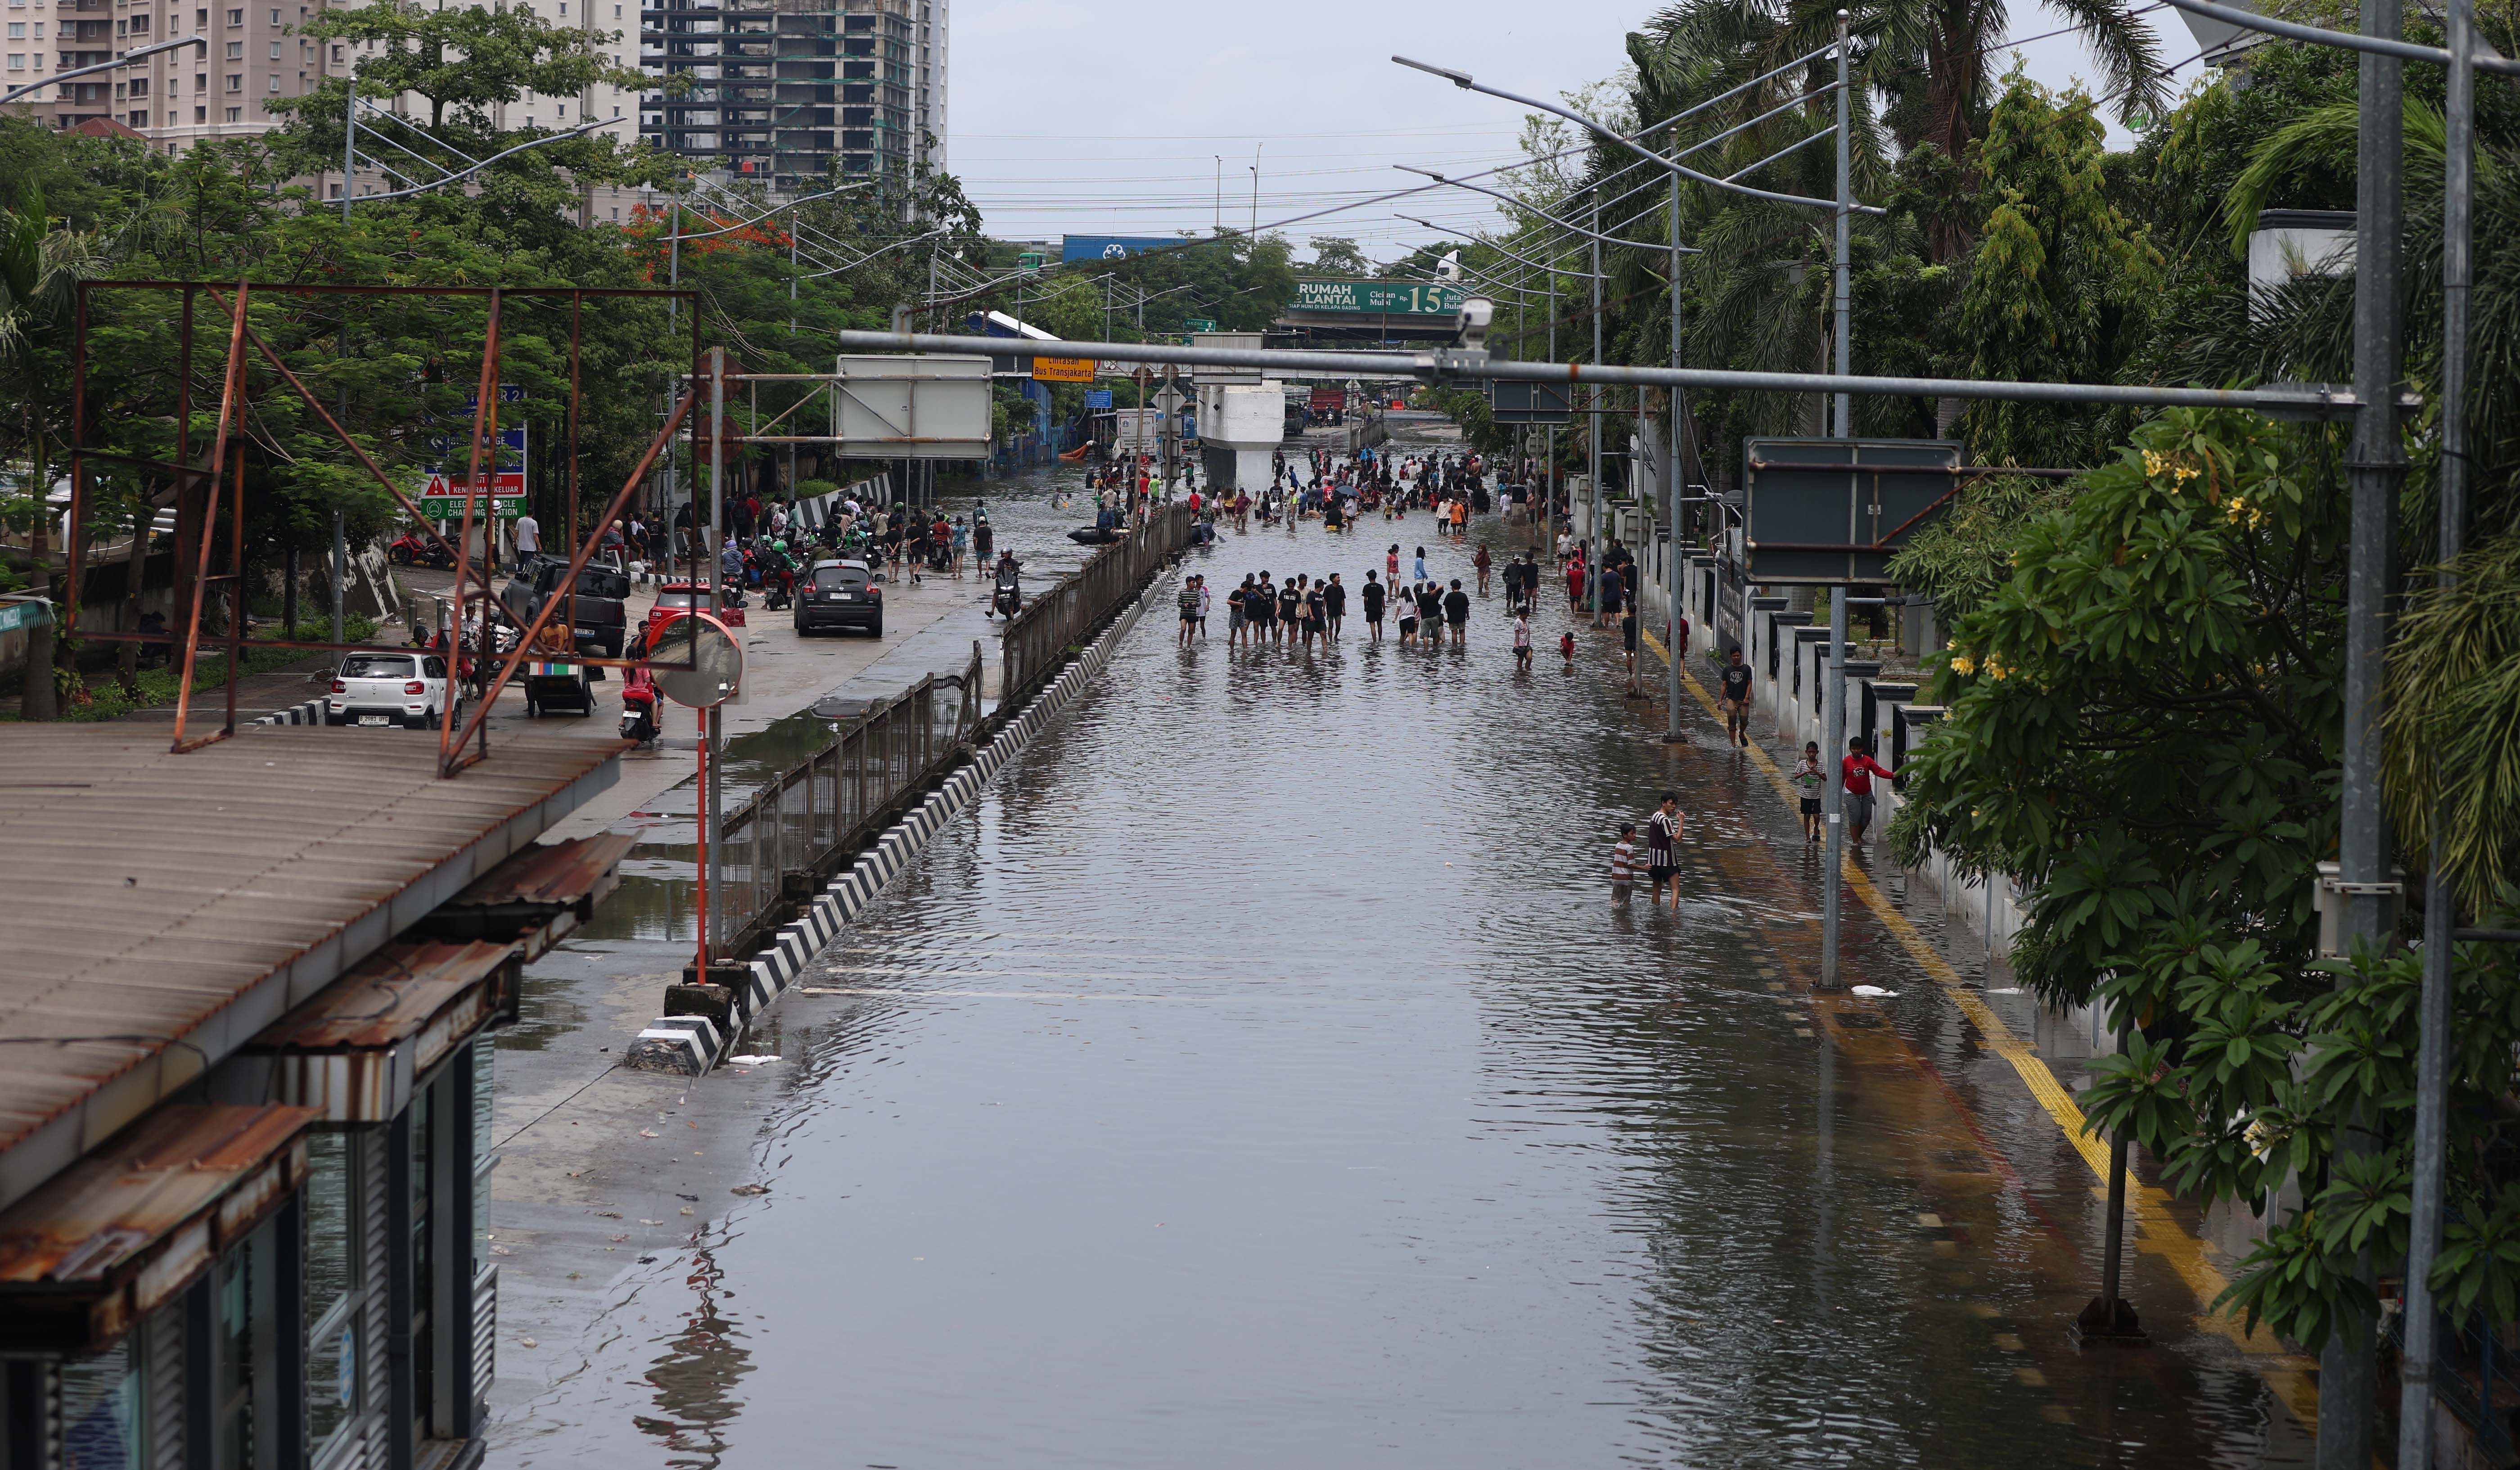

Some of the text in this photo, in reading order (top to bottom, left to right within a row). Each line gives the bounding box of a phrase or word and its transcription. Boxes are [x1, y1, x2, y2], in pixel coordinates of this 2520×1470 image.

[1299, 284, 1351, 295] RUMAH
[1306, 294, 1356, 305] LANTAI
[1408, 287, 1442, 313] 15
[1035, 367, 1091, 379] Bus Transjakarta
[512, 390, 519, 402] 2
[450, 500, 483, 508] ELECRIC
